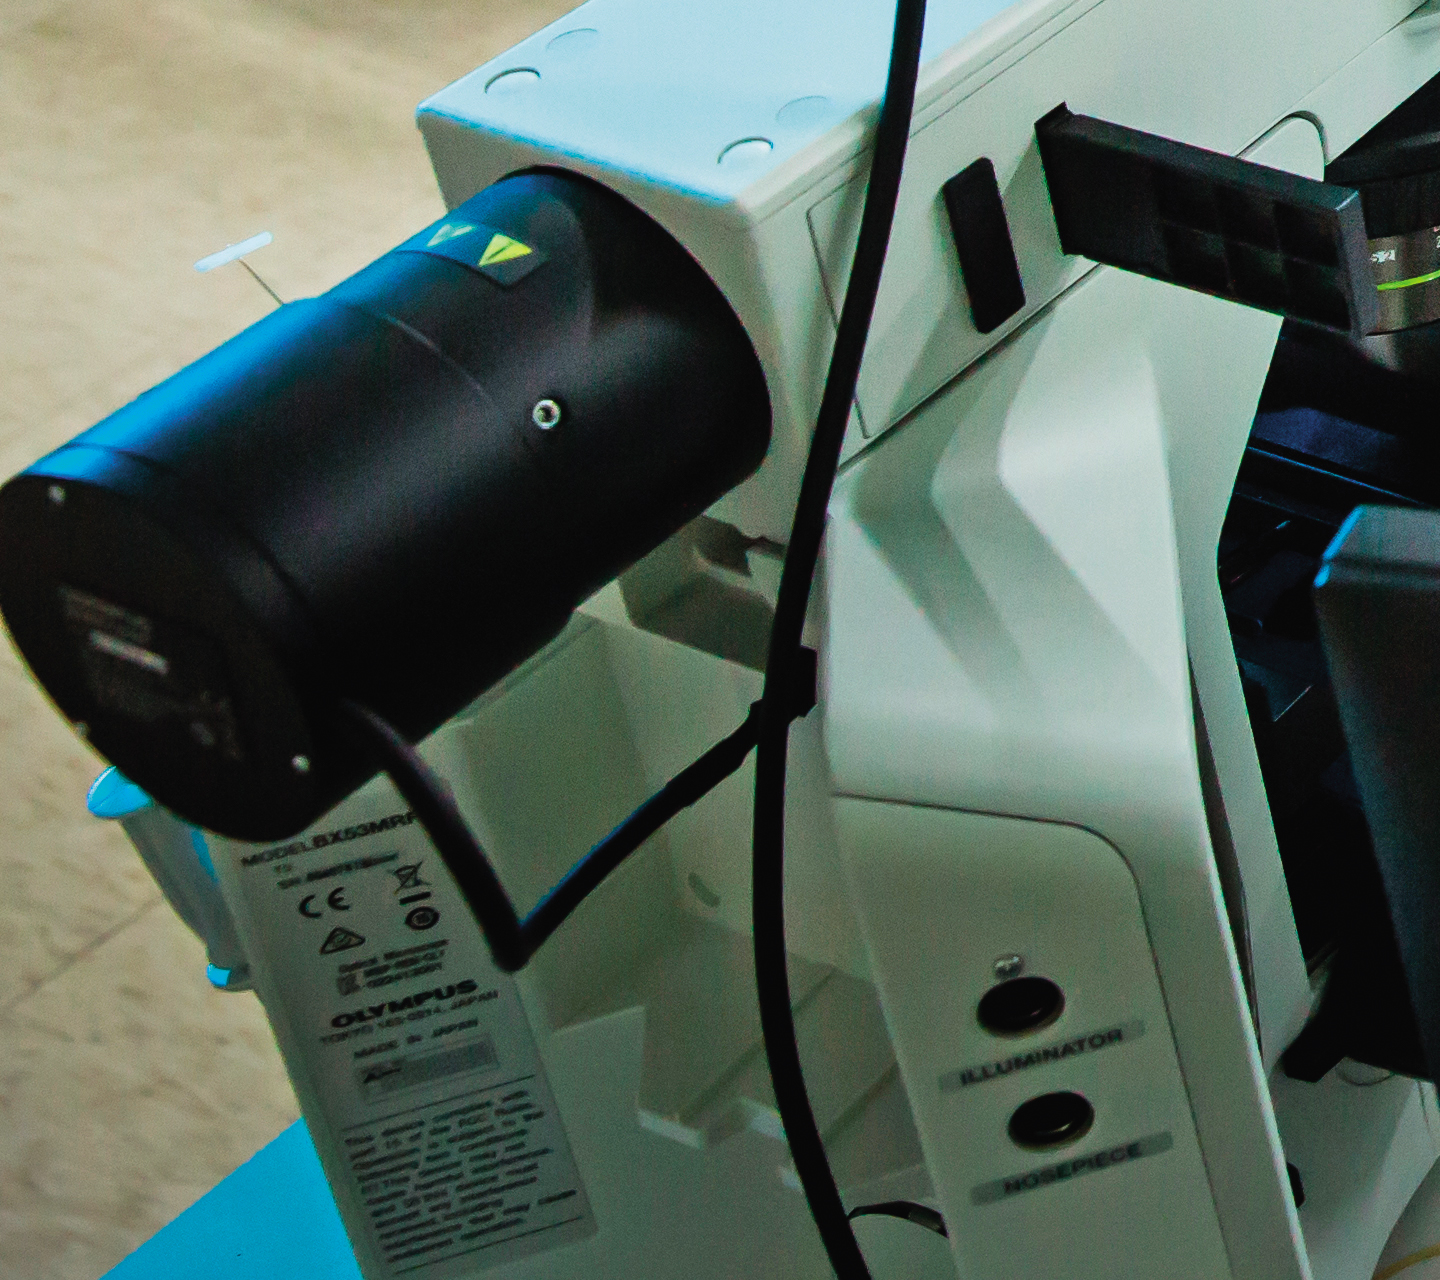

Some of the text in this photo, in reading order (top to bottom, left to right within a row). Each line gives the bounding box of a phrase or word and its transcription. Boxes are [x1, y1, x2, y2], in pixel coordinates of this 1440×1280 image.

[299, 886, 350, 918] CE
[331, 979, 479, 1028] OLYMPUS
[960, 1028, 1123, 1086] ILLUMINATOR
[1003, 1142, 1142, 1194] NOSEPIECE
